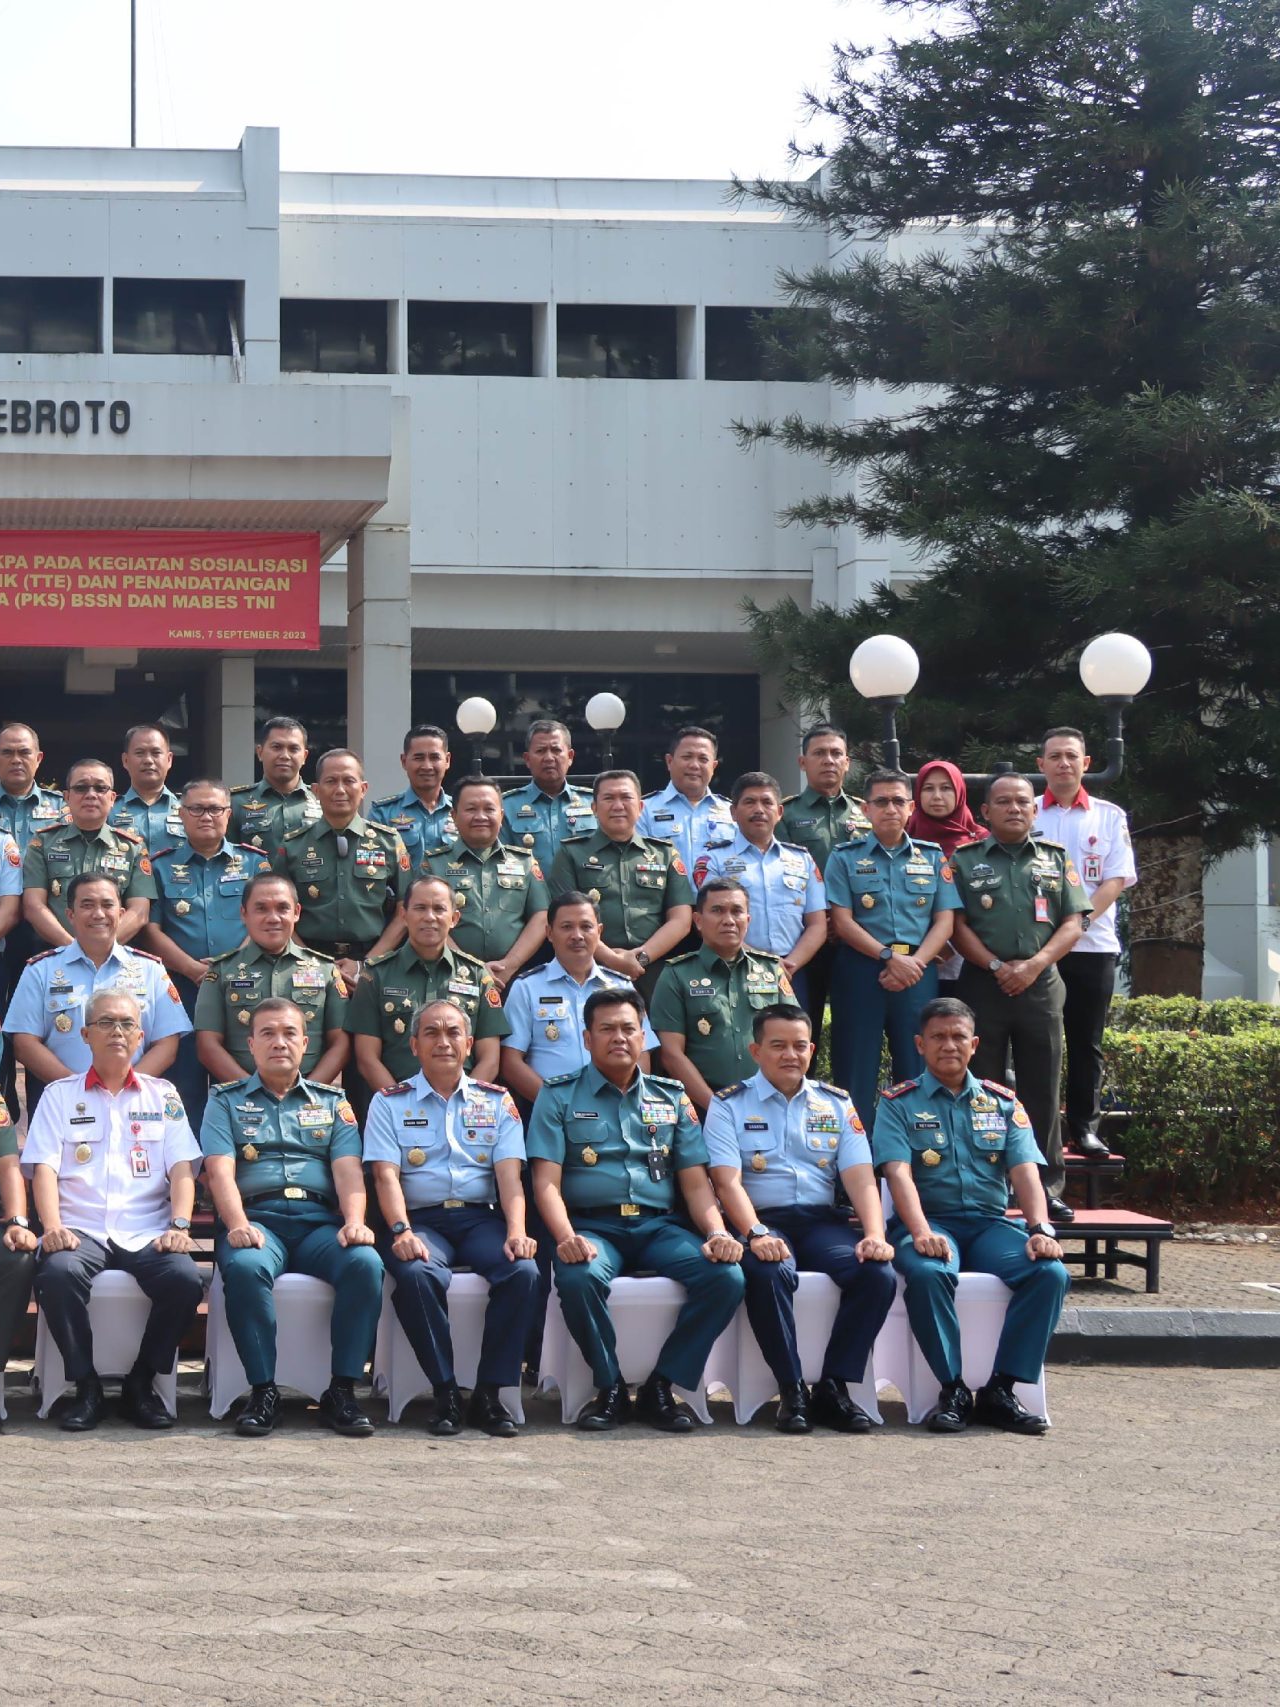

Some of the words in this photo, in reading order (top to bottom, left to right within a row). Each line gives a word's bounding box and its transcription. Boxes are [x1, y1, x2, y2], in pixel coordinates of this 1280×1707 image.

[33, 555, 83, 570] PADA
[88, 556, 184, 572] KEGIATAN
[190, 558, 308, 573] SOSIALISASI
[23, 574, 72, 592] (TTE)
[77, 575, 117, 589] DAN
[122, 575, 291, 592] PENANDATANGAN
[15, 592, 66, 610] (PKS)
[71, 593, 122, 608] BSSN
[128, 594, 167, 609] DAN
[172, 594, 238, 609] MABES
[243, 595, 276, 610] TNI
[168, 630, 205, 641] KAMIS,
[207, 630, 214, 639] 7
[216, 630, 280, 640] SEPTEMBER
[282, 631, 306, 640] 2023
